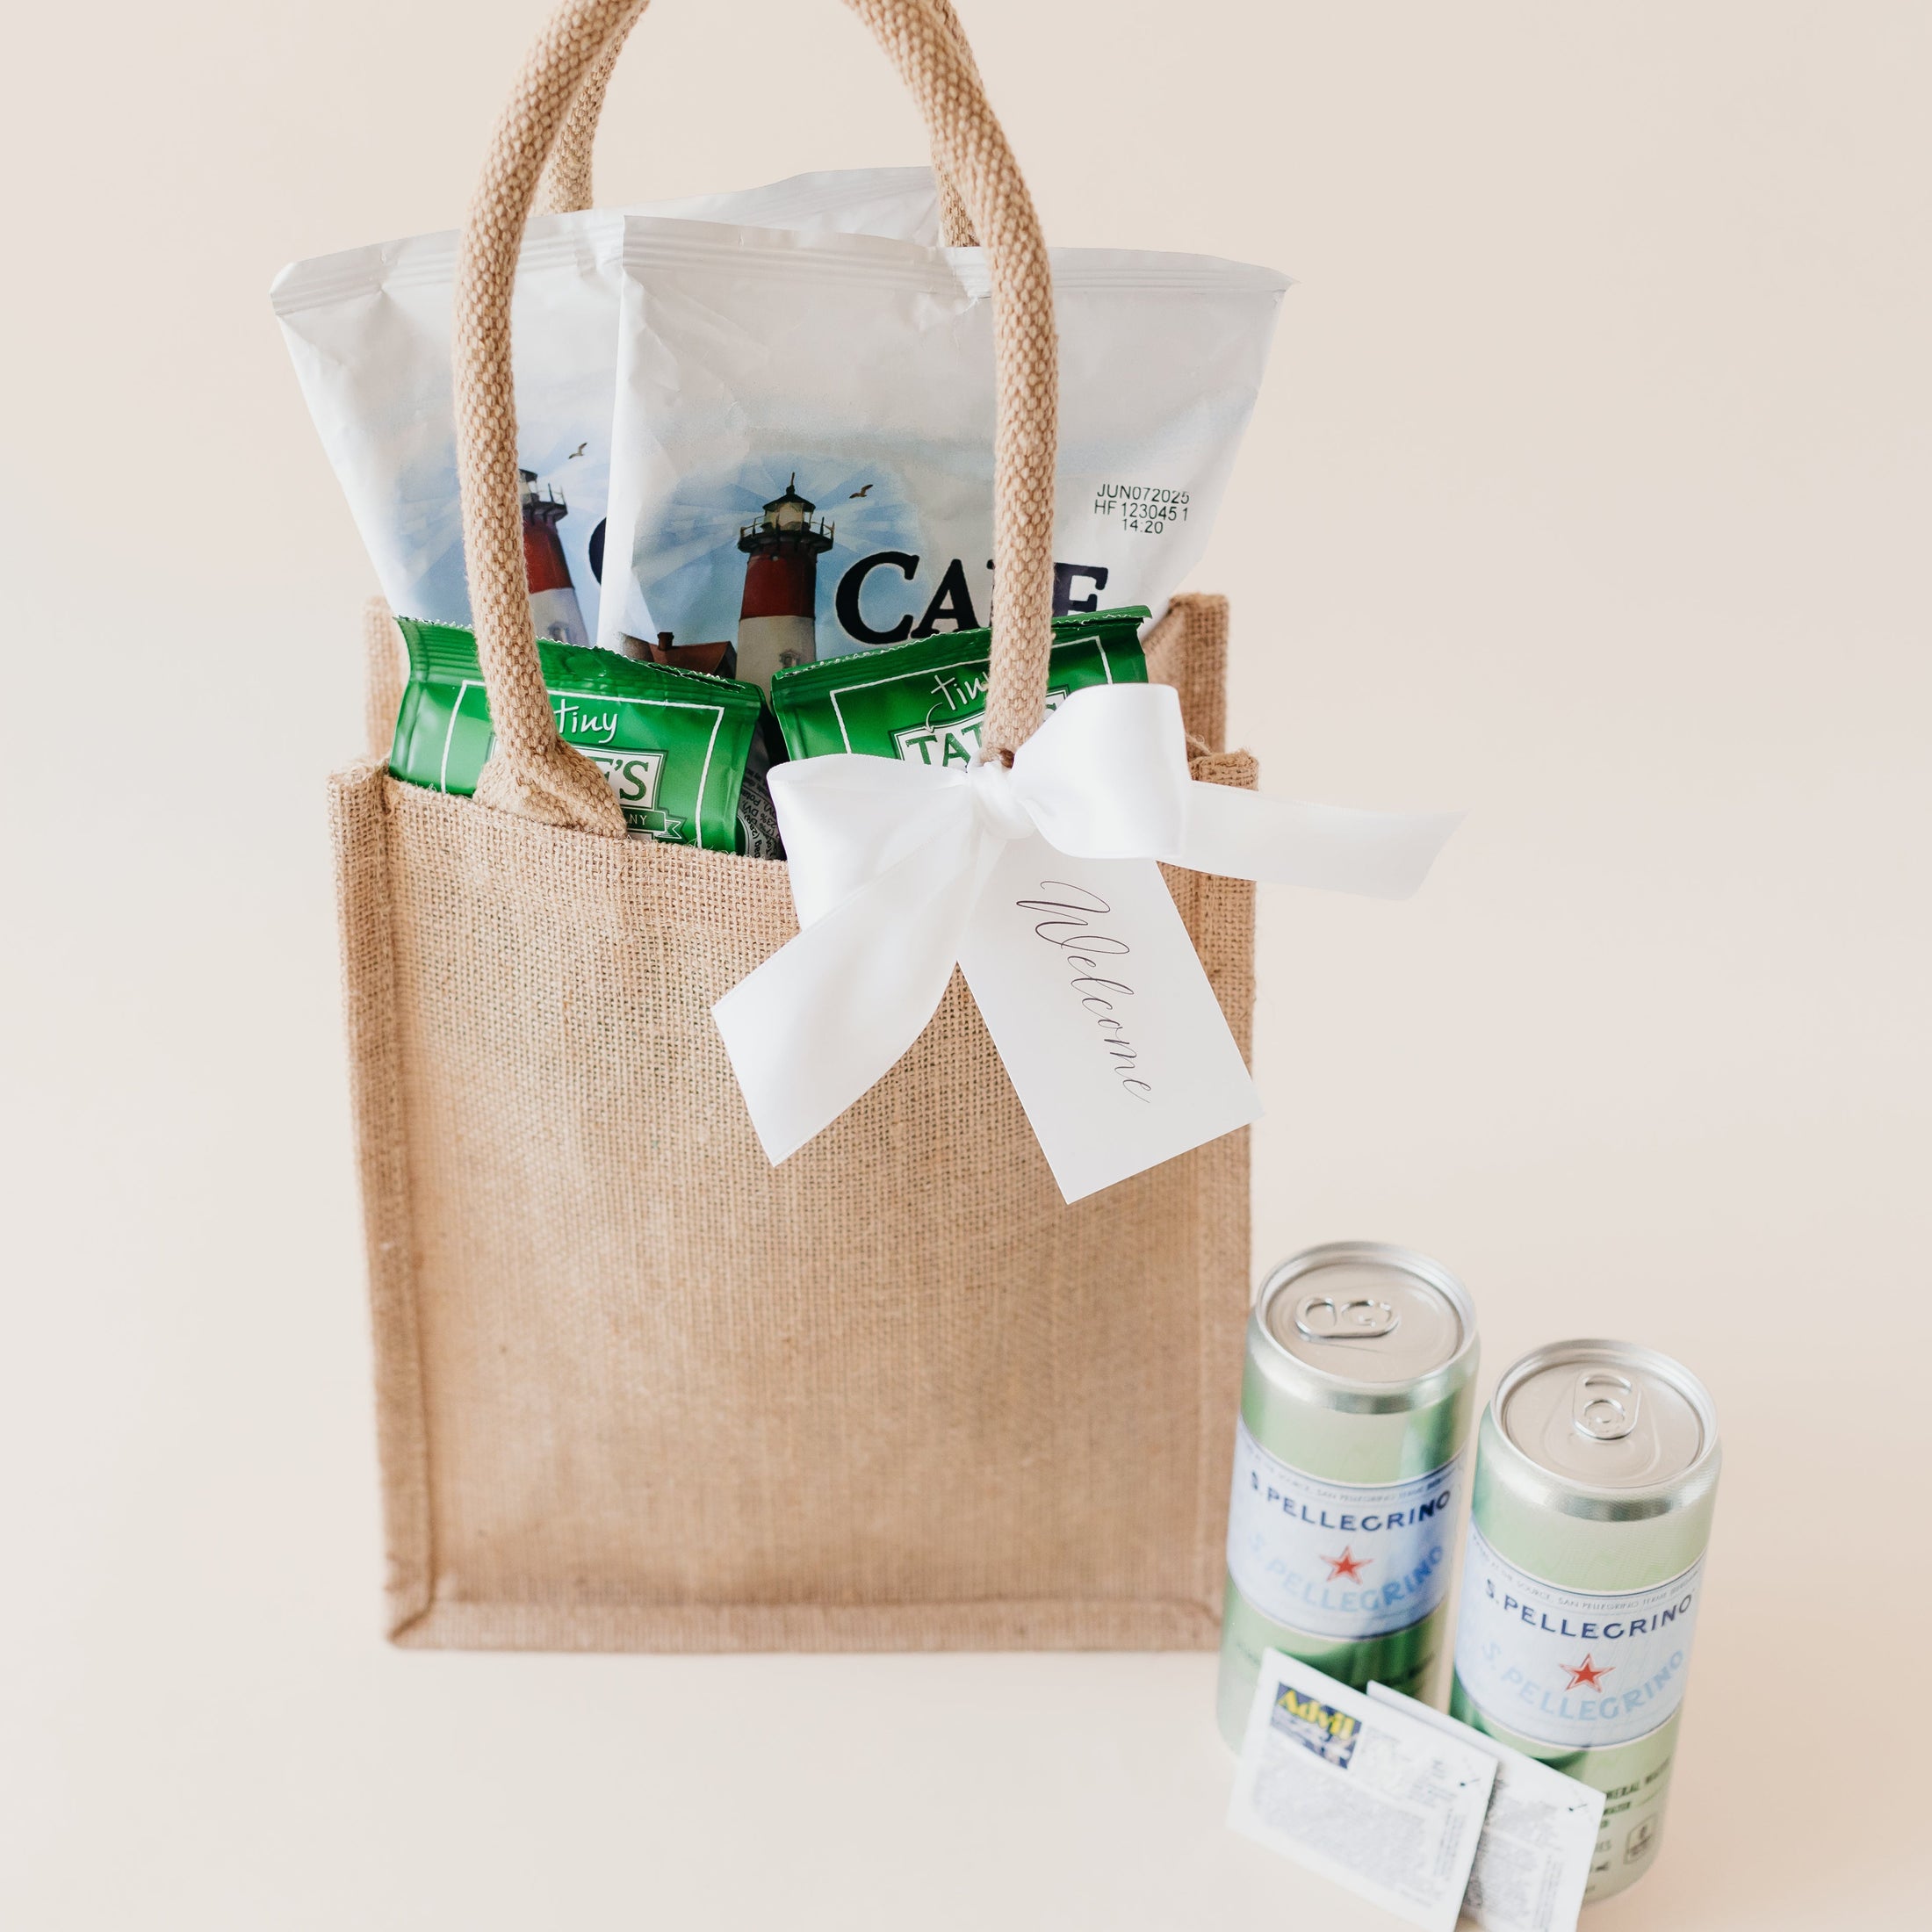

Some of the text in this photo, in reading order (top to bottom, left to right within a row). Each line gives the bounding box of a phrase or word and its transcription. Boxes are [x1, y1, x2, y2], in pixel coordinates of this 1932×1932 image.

[1094, 499, 1117, 515] HF
[1097, 483, 1190, 505] JUN072025
[1122, 518, 1164, 534] 14:20
[835, 550, 1109, 645] CAE
[931, 672, 990, 710] tin
[553, 698, 618, 744] tiny
[1016, 880, 1151, 1104] Welcome
[1277, 1688, 1356, 1740] Advil
